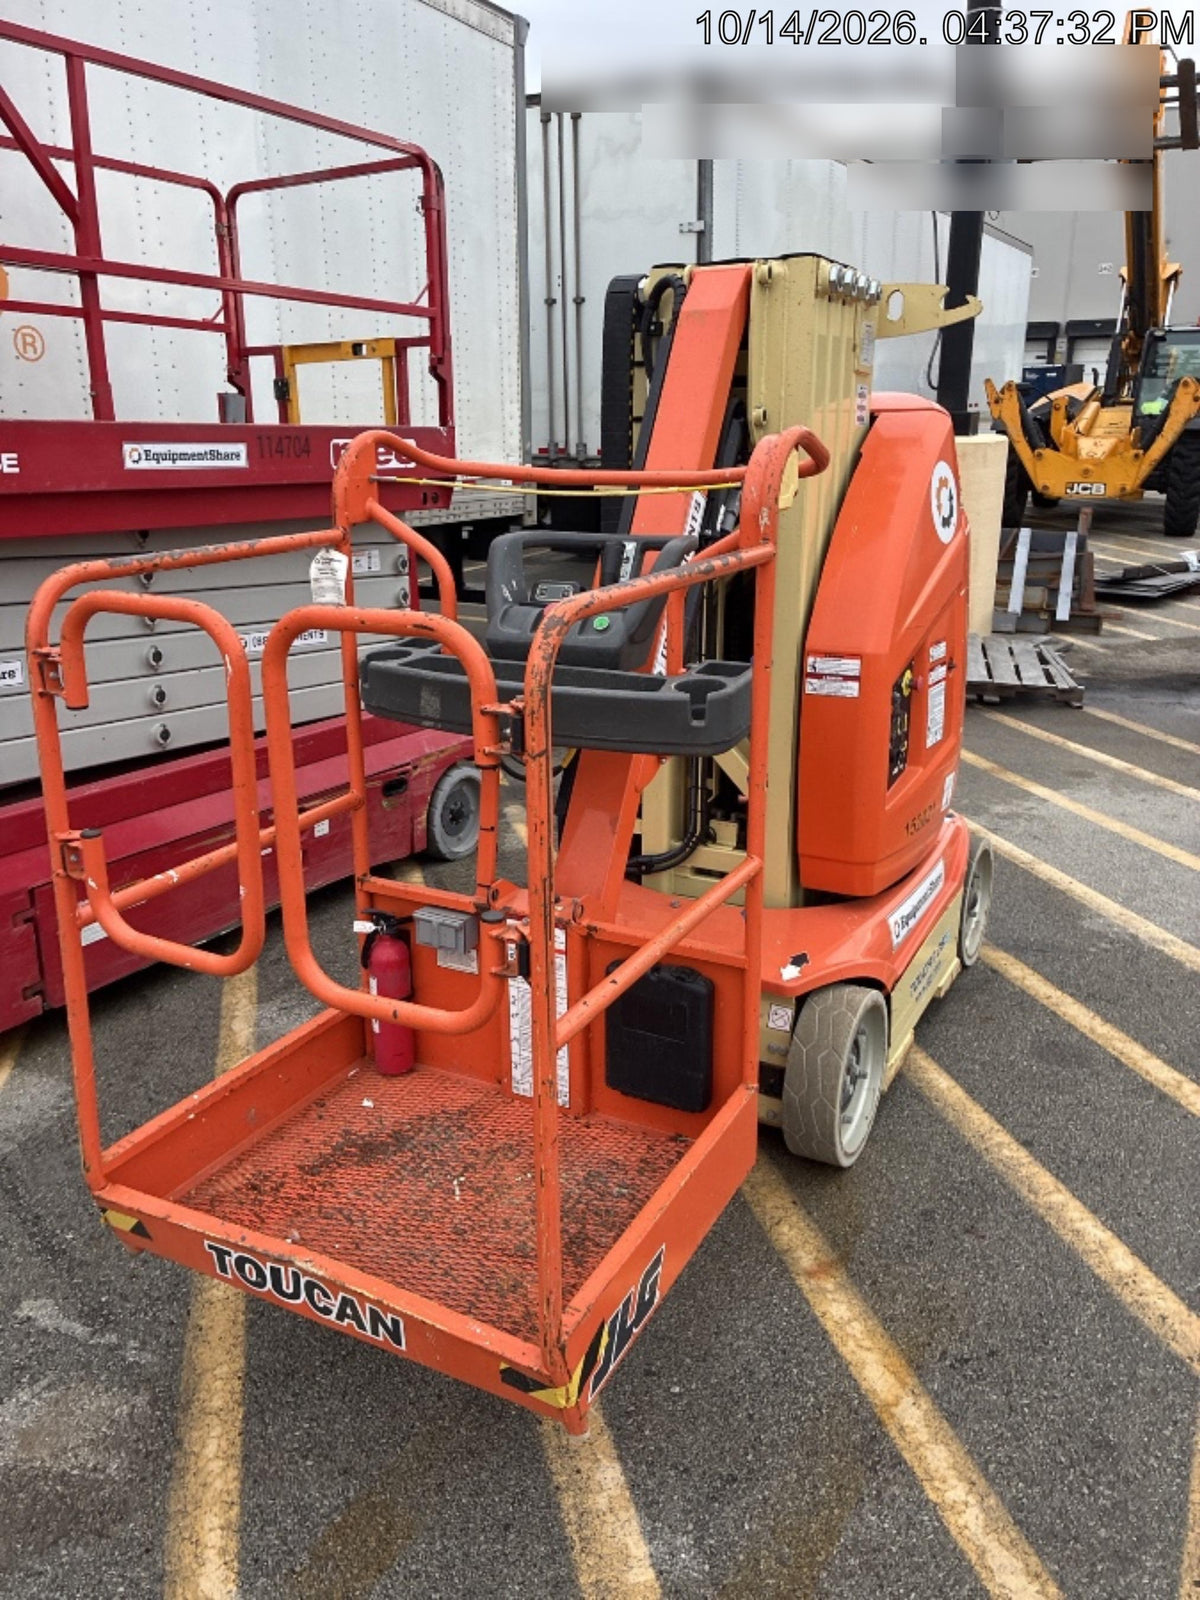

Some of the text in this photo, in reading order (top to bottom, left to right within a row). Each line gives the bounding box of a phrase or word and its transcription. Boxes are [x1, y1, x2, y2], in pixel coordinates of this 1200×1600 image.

[143, 448, 241, 465] EquipmentShare
[257, 435, 311, 458] 114704
[1066, 483, 1105, 495] JCB
[0, 669, 16, 680] re
[204, 1240, 406, 1351] TOUCAN
[588, 1244, 666, 1403] JLG
